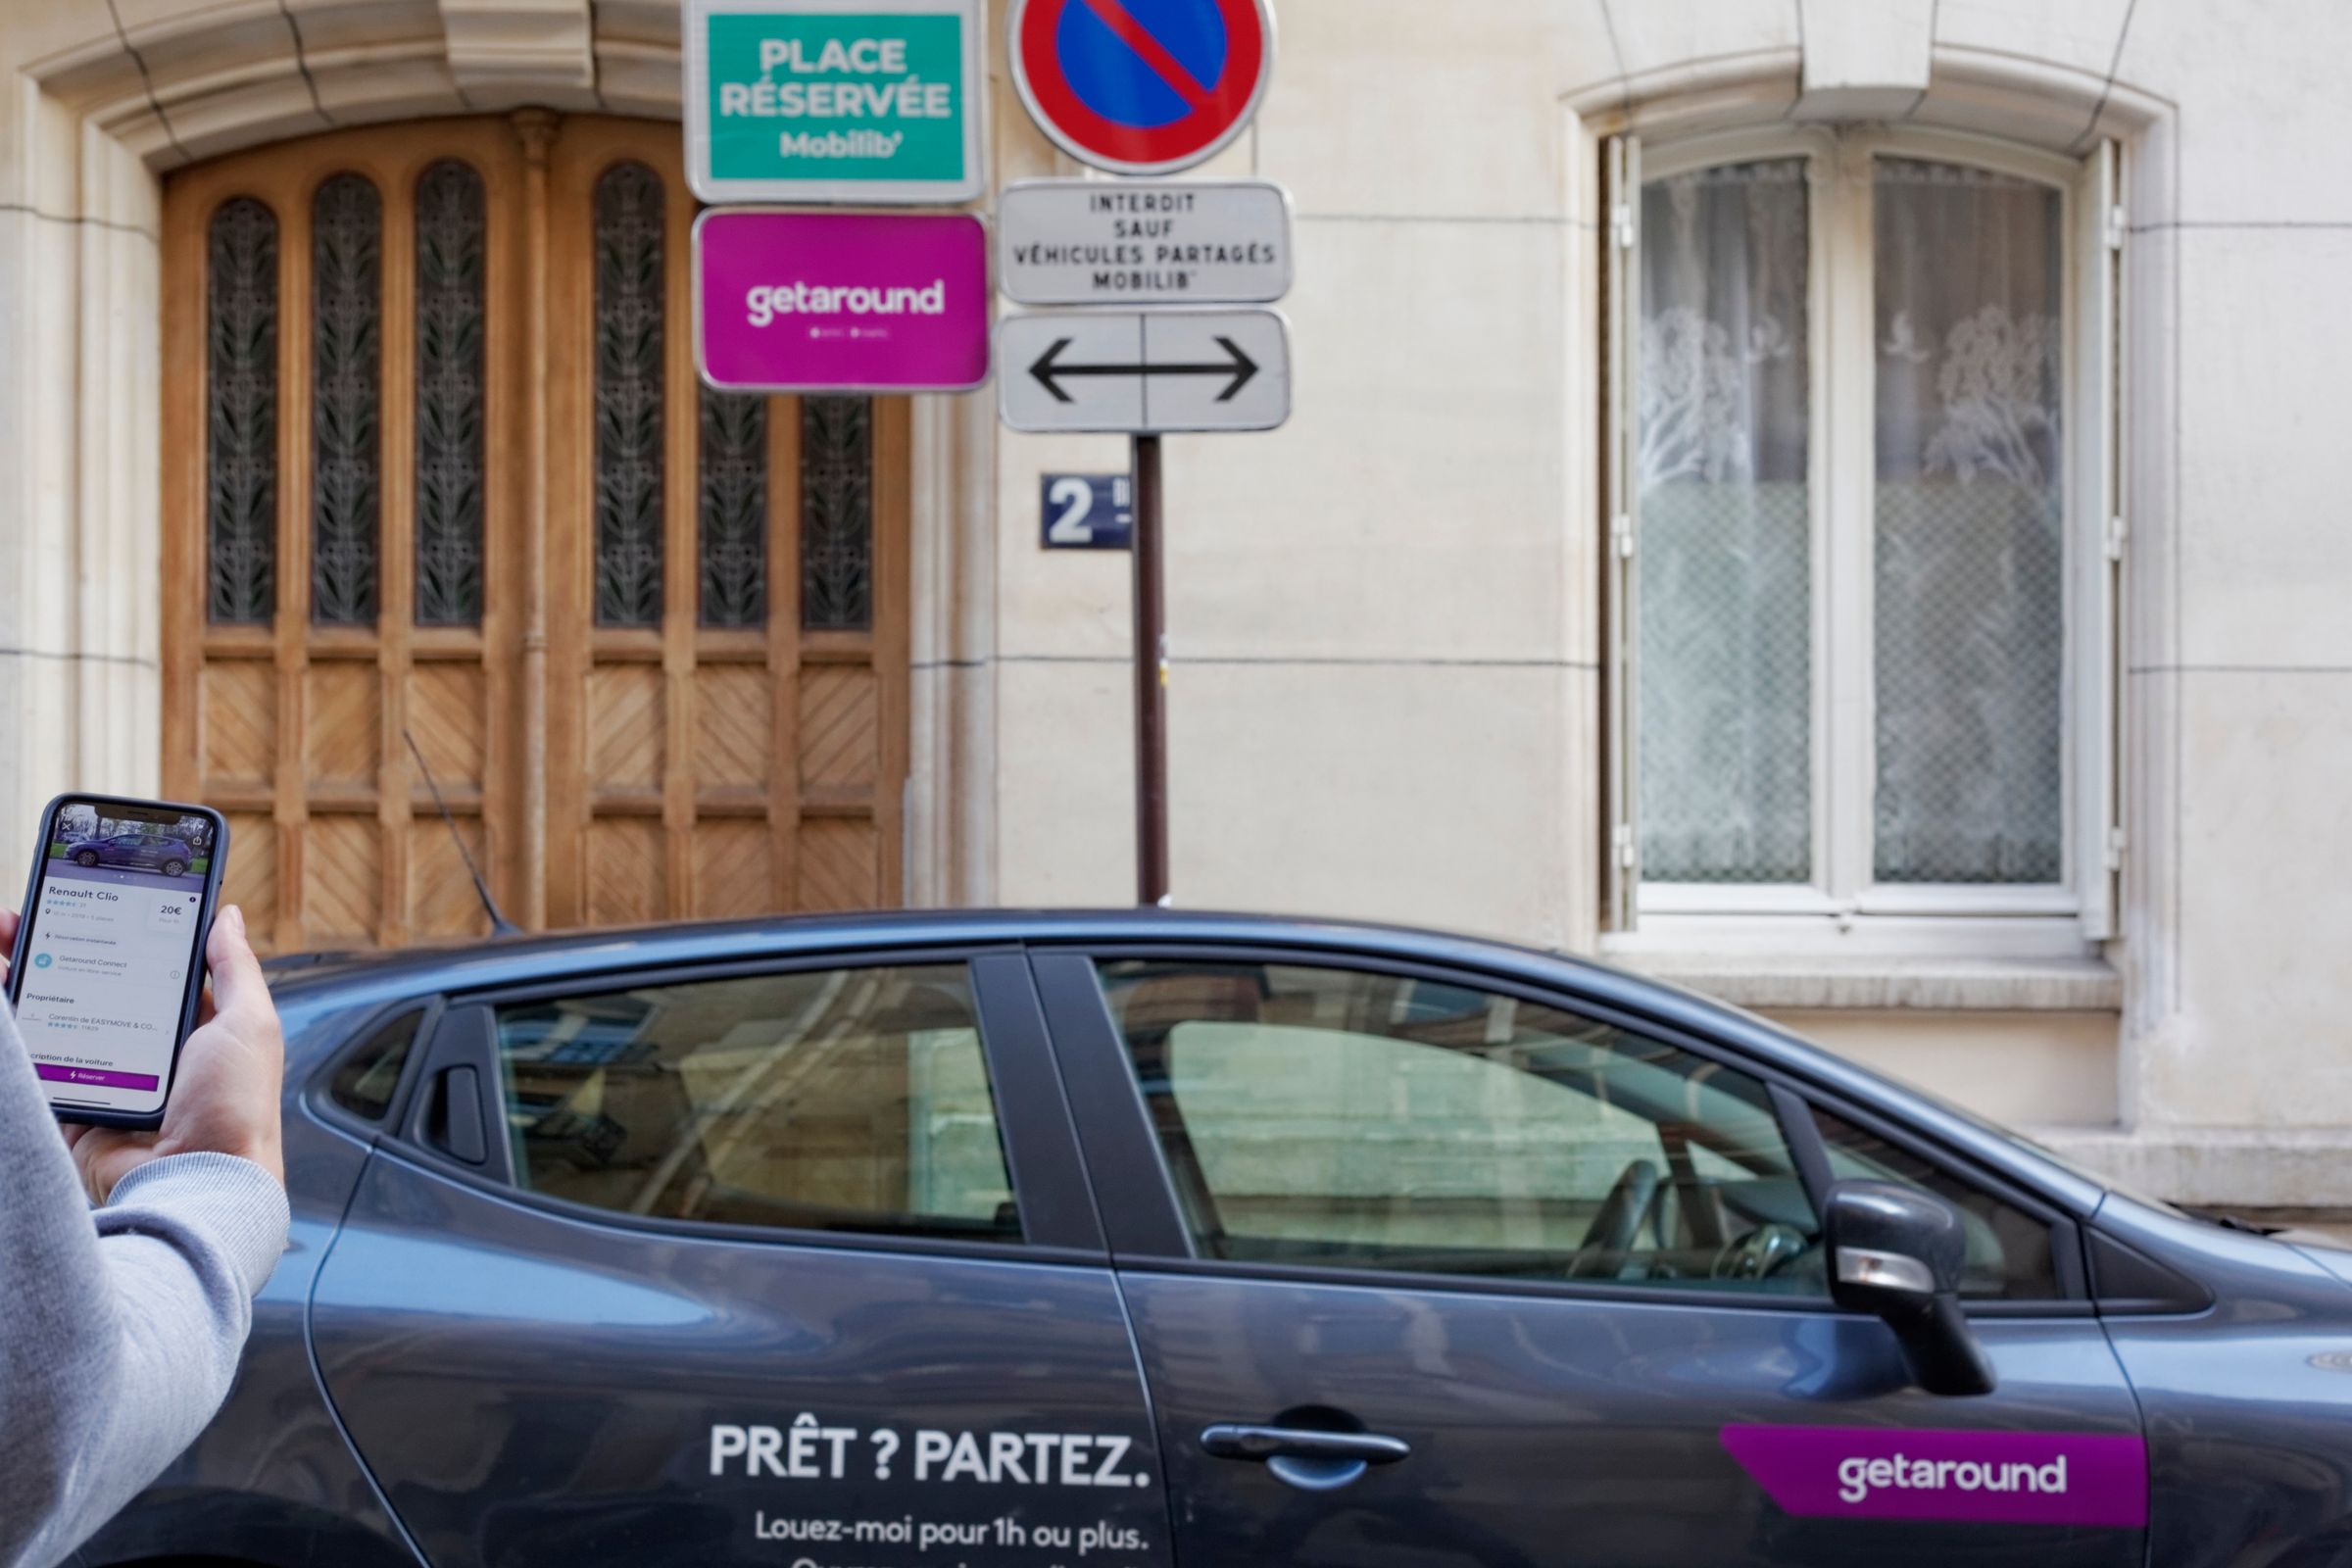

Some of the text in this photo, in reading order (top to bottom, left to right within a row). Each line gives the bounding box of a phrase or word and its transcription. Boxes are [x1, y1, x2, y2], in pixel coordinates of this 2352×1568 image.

[760, 38, 906, 73] PLACE
[719, 74, 952, 119] RÉSERVÉE
[1090, 193, 1195, 213] INTERDIT
[1114, 220, 1174, 238] SAUF
[1014, 241, 1276, 265] VÉHICULES PARTAGÉS
[747, 280, 945, 327] getaround
[1049, 476, 1093, 543] 2
[49, 886, 119, 902] Renault Clio
[160, 905, 182, 915] 20€
[59, 955, 127, 968] Getaround Connect
[26, 993, 74, 1004] Propriétaire
[90, 1018, 131, 1028] EASYMOVE
[30, 1053, 62, 1062] cription
[710, 1412, 1151, 1488] PRÊT ? PARTEZ.
[1838, 1453, 2068, 1503] getaround
[756, 1511, 1150, 1555] Louez-moi pour 1h ou plus.
